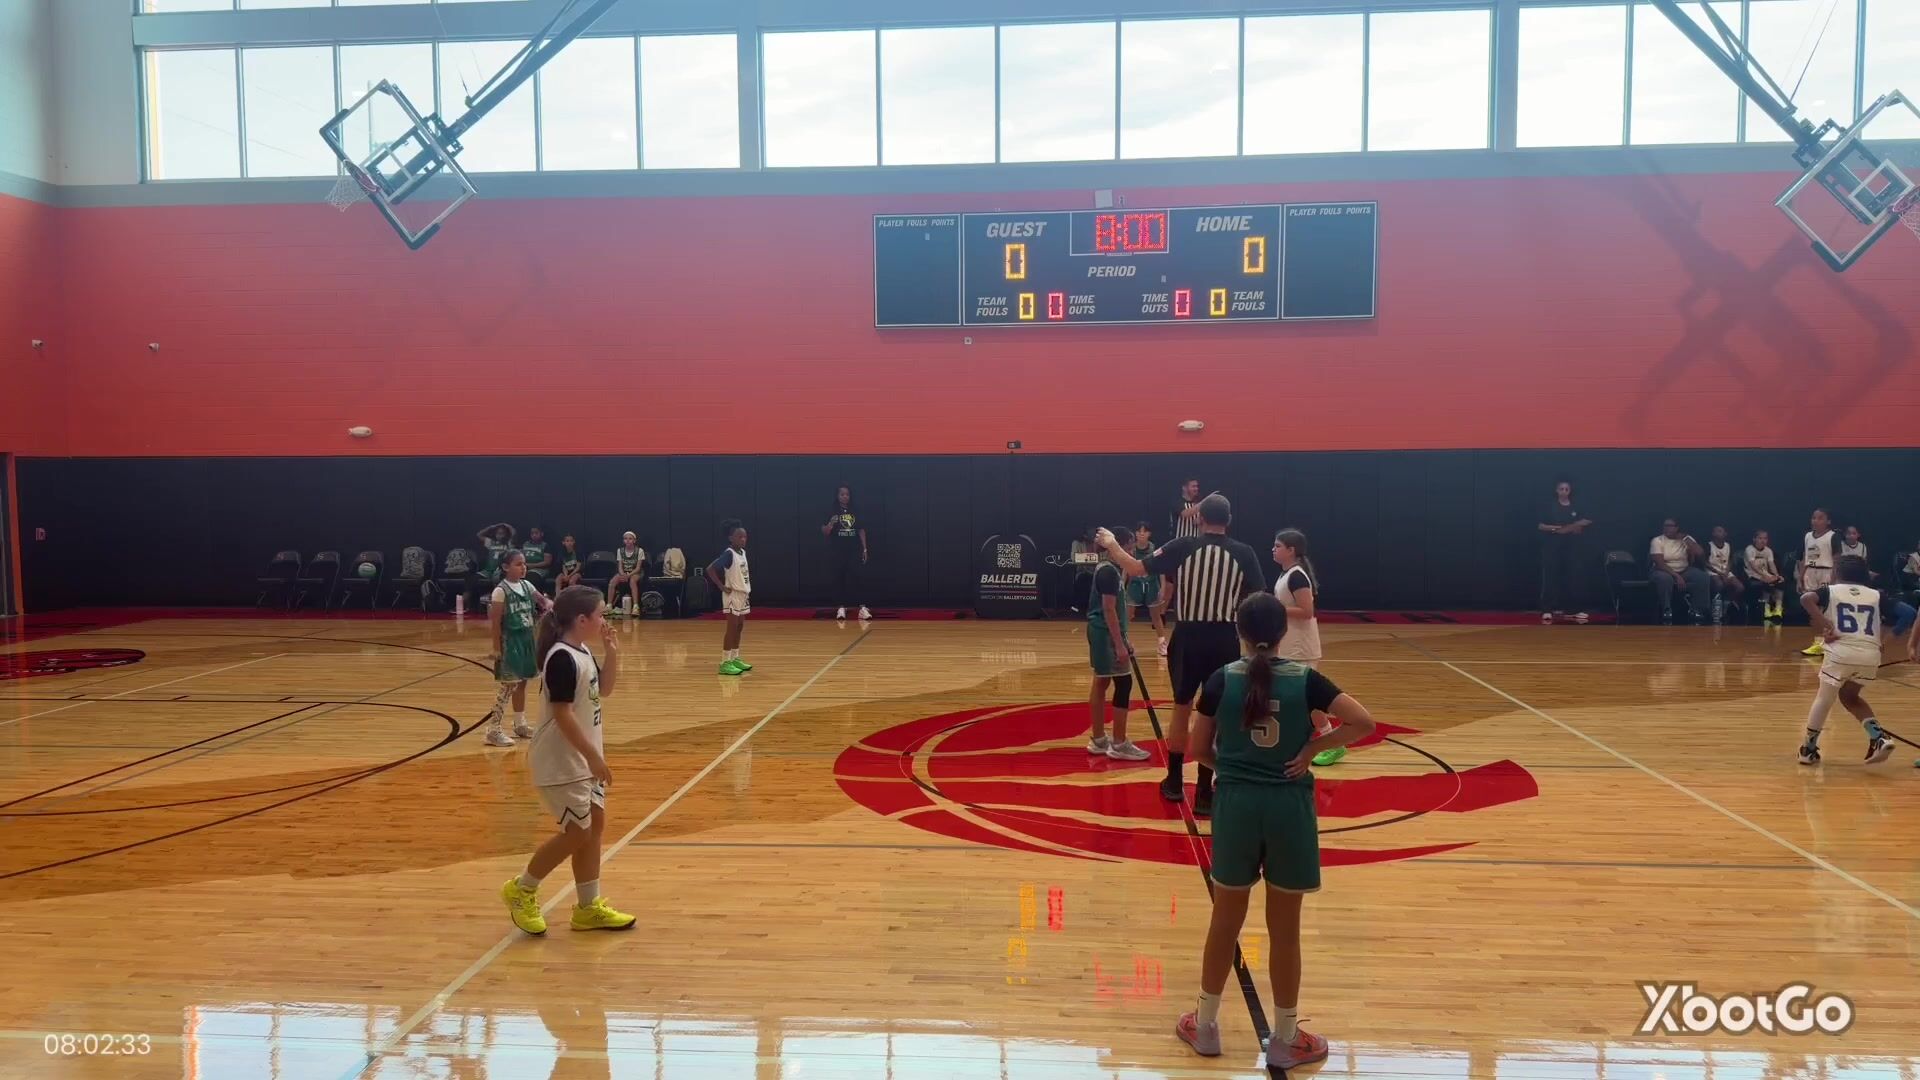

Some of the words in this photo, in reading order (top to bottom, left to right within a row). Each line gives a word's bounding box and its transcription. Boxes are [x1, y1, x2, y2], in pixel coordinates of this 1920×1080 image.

[1290, 208, 1317, 216] PLAYER
[1319, 207, 1341, 215] FOULS
[1346, 207, 1371, 215] POINTS
[879, 219, 904, 227] PLAYER
[906, 218, 927, 226] FOULS
[931, 218, 955, 226] POINTS
[1195, 215, 1253, 232] HOME
[986, 221, 1047, 238] GUEST
[1096, 213, 1166, 251] 8:00
[1005, 243, 1026, 279] 0
[1243, 236, 1266, 274] 0
[1087, 265, 1137, 278] PERIOD
[977, 296, 1007, 306] TEAM
[1068, 294, 1096, 304] TIME
[1142, 293, 1169, 303] TIME
[1174, 289, 1191, 316] 0
[1209, 288, 1227, 316] 0
[1232, 291, 1265, 301] TEAM
[976, 306, 1009, 317] FOULS
[1019, 292, 1035, 320] 0
[1048, 292, 1064, 319] 0
[1068, 305, 1096, 315] OUTS
[1141, 303, 1169, 313] OUTS
[1231, 301, 1266, 311] FOULS
[980, 574, 1021, 584] BALLER
[1836, 602, 1875, 636] 67
[1250, 699, 1280, 748] 5
